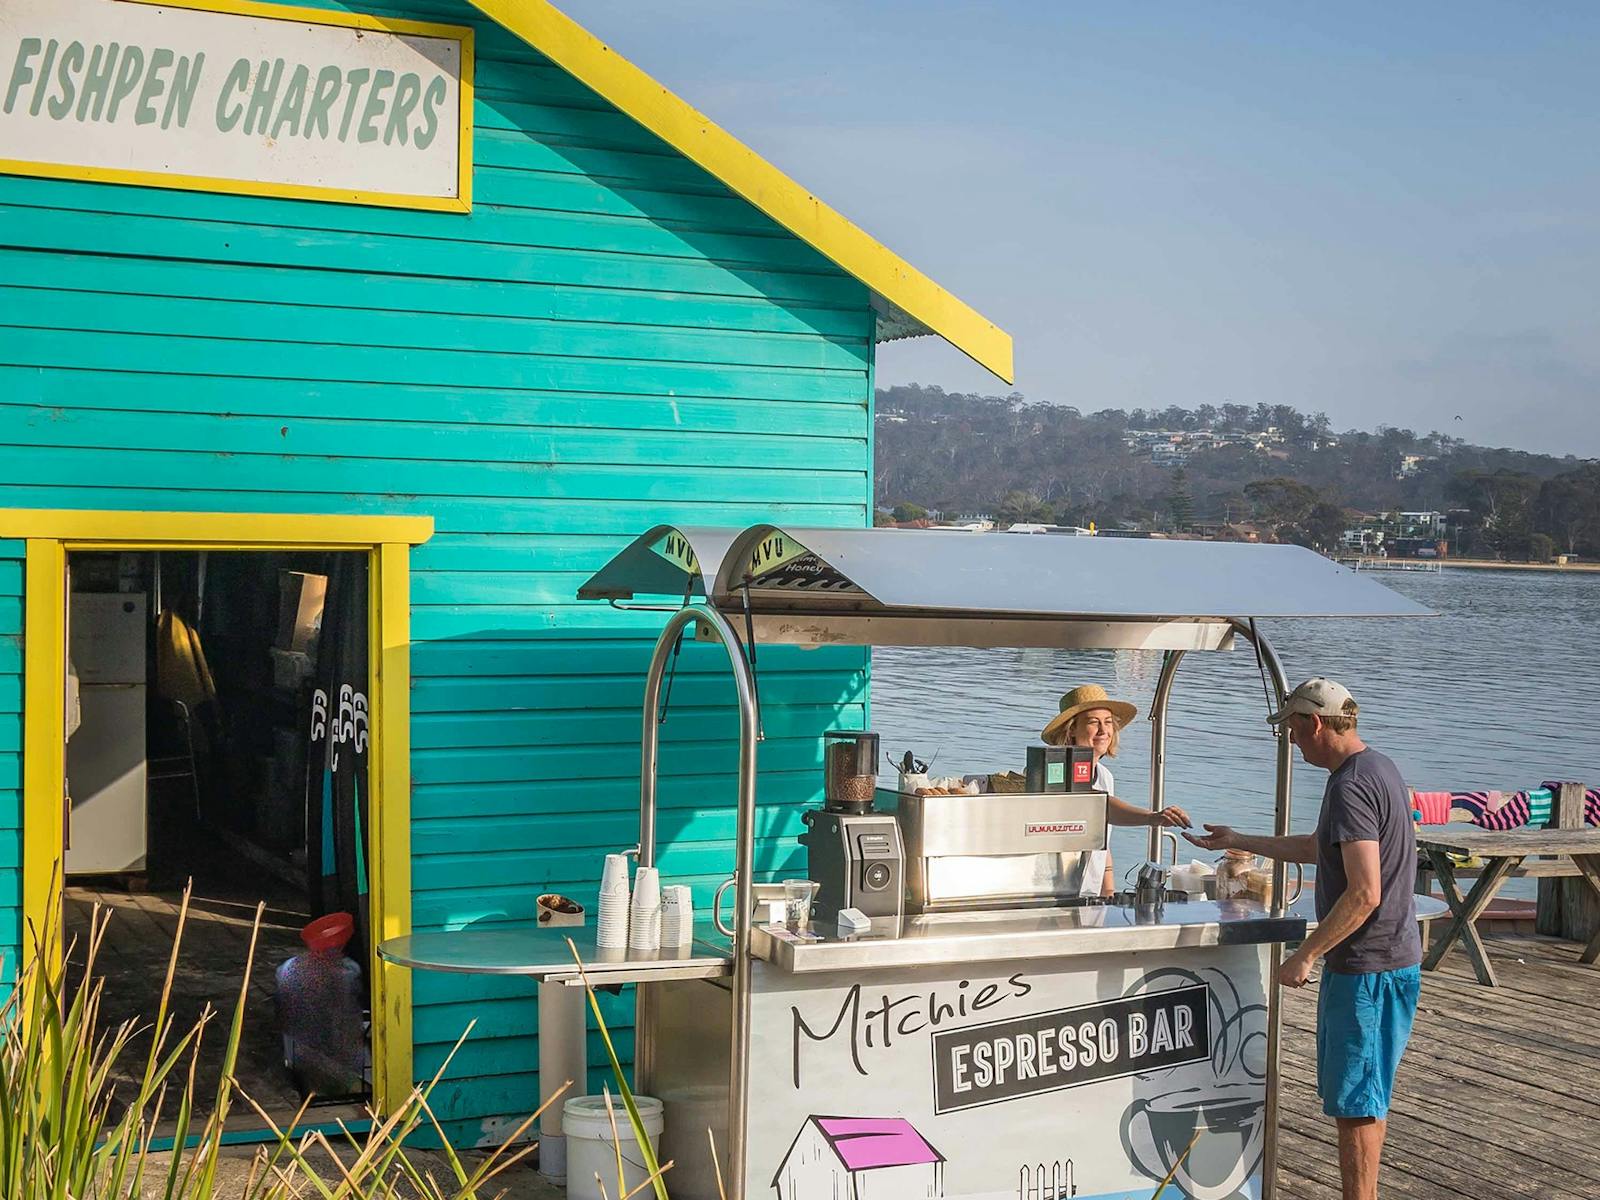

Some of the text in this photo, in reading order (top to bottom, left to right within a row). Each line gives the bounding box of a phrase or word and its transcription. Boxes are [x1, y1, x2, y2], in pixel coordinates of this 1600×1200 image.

[3, 38, 447, 150] FISHPEN CHARTERS
[785, 563, 823, 575] Honey
[1077, 765, 1088, 775] T2
[791, 973, 1032, 1089] Mitchies
[951, 1004, 1194, 1093] ESPRESSO BAR
